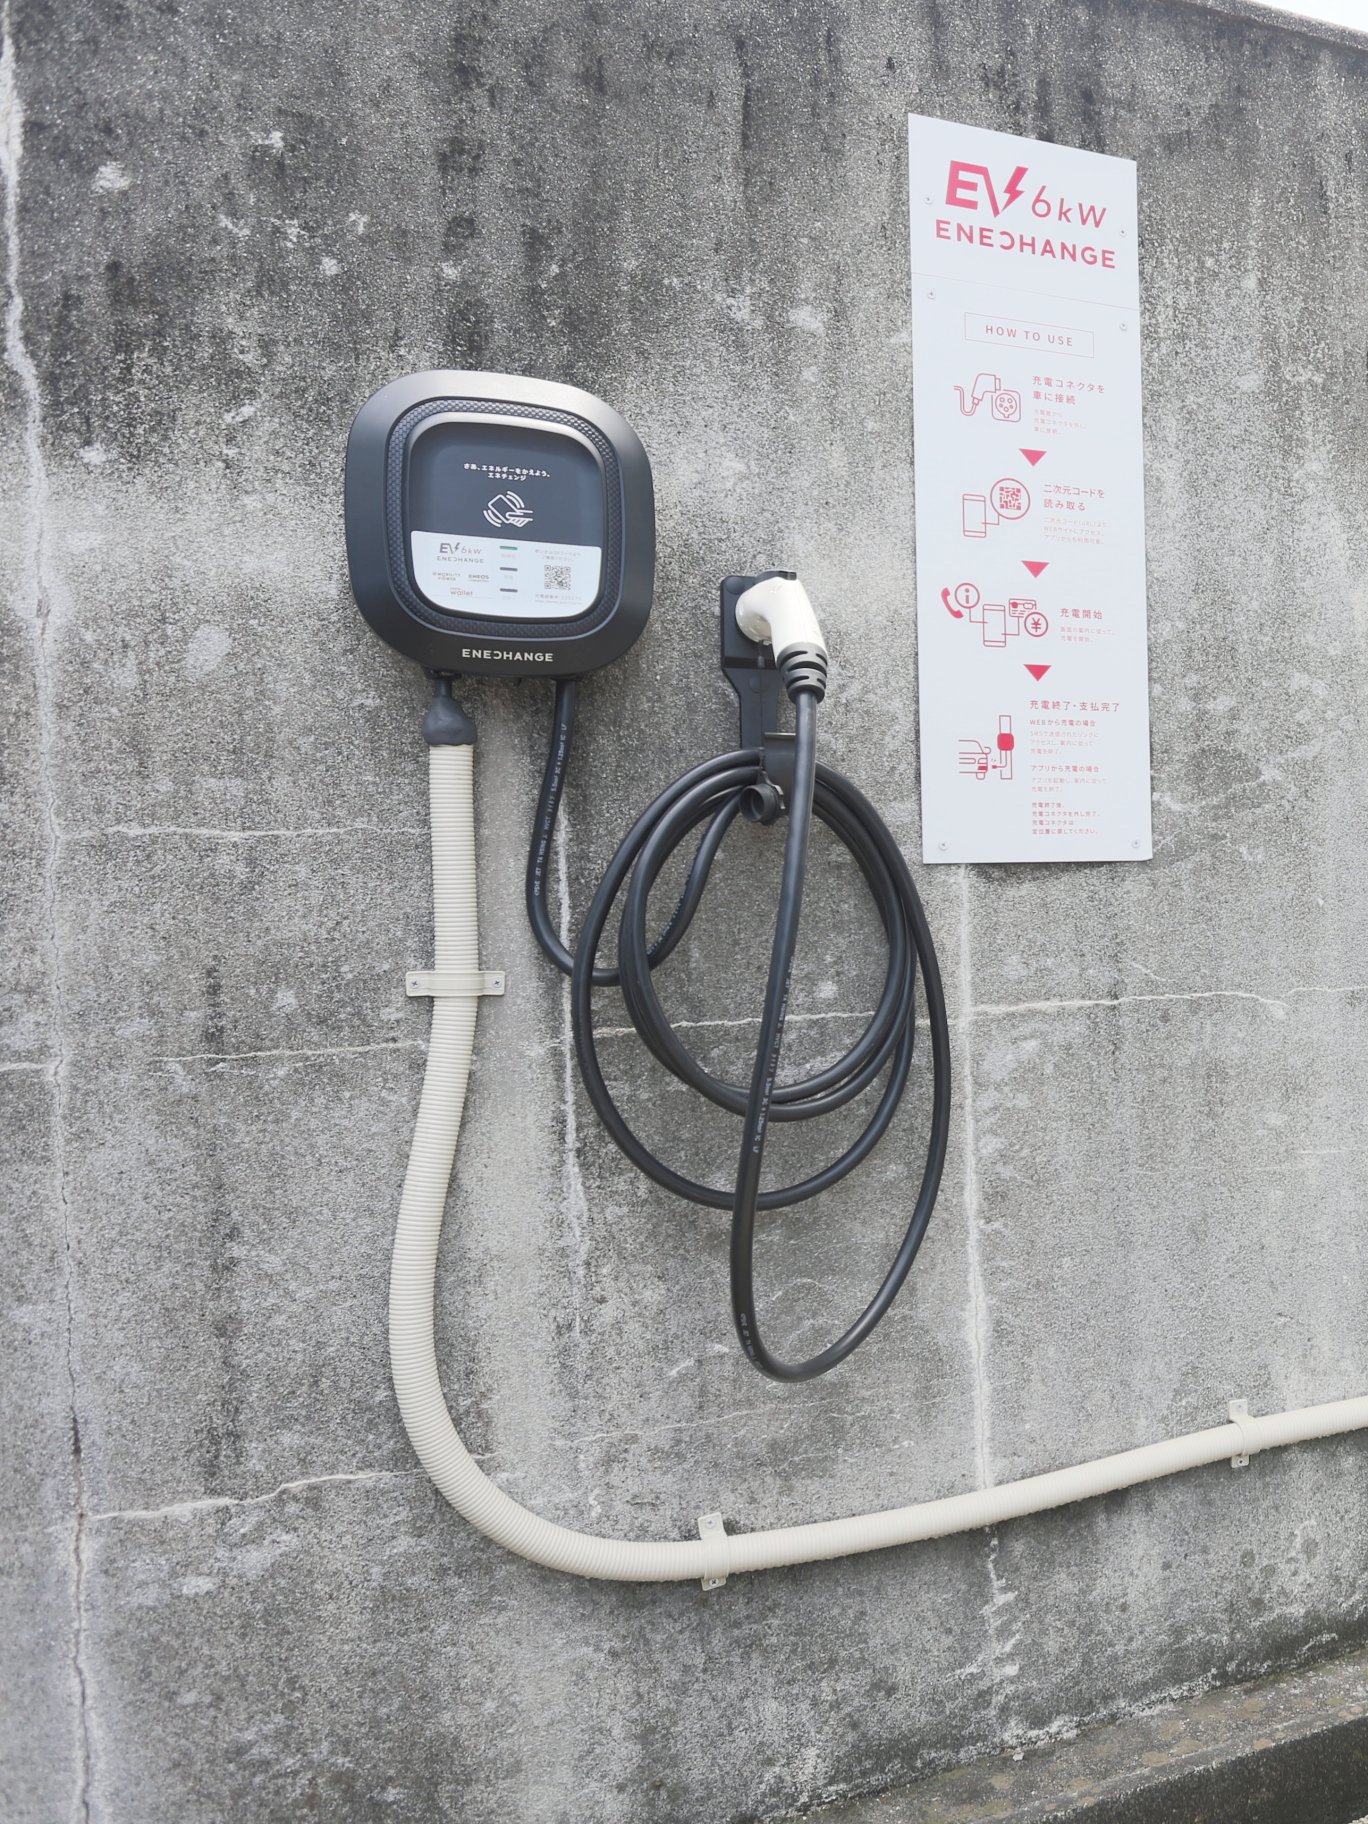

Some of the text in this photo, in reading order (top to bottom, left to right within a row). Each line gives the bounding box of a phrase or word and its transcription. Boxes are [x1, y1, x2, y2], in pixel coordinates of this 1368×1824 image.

[946, 160, 1107, 228] EV 6kW
[985, 324, 1073, 347] HOW TO USE
[1033, 375, 1105, 394] 充電コネクタを
[1033, 390, 1075, 405] 車に接続
[463, 463, 550, 478] さあ、エネルギーをかえよう。
[488, 472, 527, 481] エネチェンジ
[1043, 484, 1105, 499] 二次元コードを
[1043, 499, 1085, 512] 読み取る
[1060, 608, 1103, 620] 充電開始
[462, 648, 554, 662] ENECHANGE
